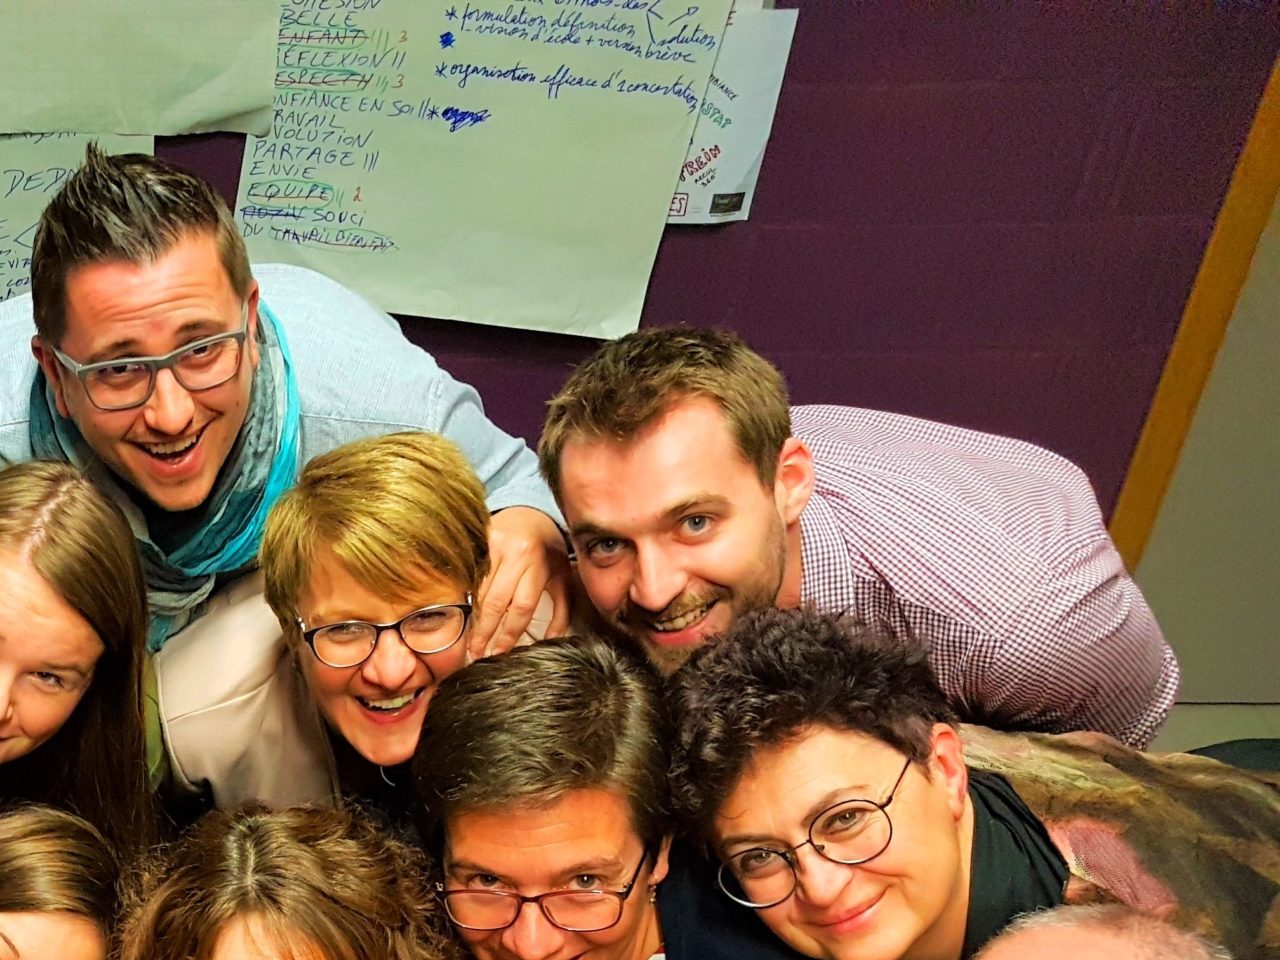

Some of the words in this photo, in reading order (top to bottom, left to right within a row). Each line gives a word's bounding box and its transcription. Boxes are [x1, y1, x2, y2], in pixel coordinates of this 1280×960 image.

[279, 8, 358, 27] BELLE
[461, 3, 547, 31] formulation
[278, 27, 366, 46] ENFANT
[277, 44, 393, 69] ÉFLEXION
[273, 91, 352, 112] NFIANCE
[358, 98, 383, 113] EN
[253, 140, 355, 167] PARTAGE
[249, 160, 317, 179] ENVIE
[243, 222, 264, 238] DU
